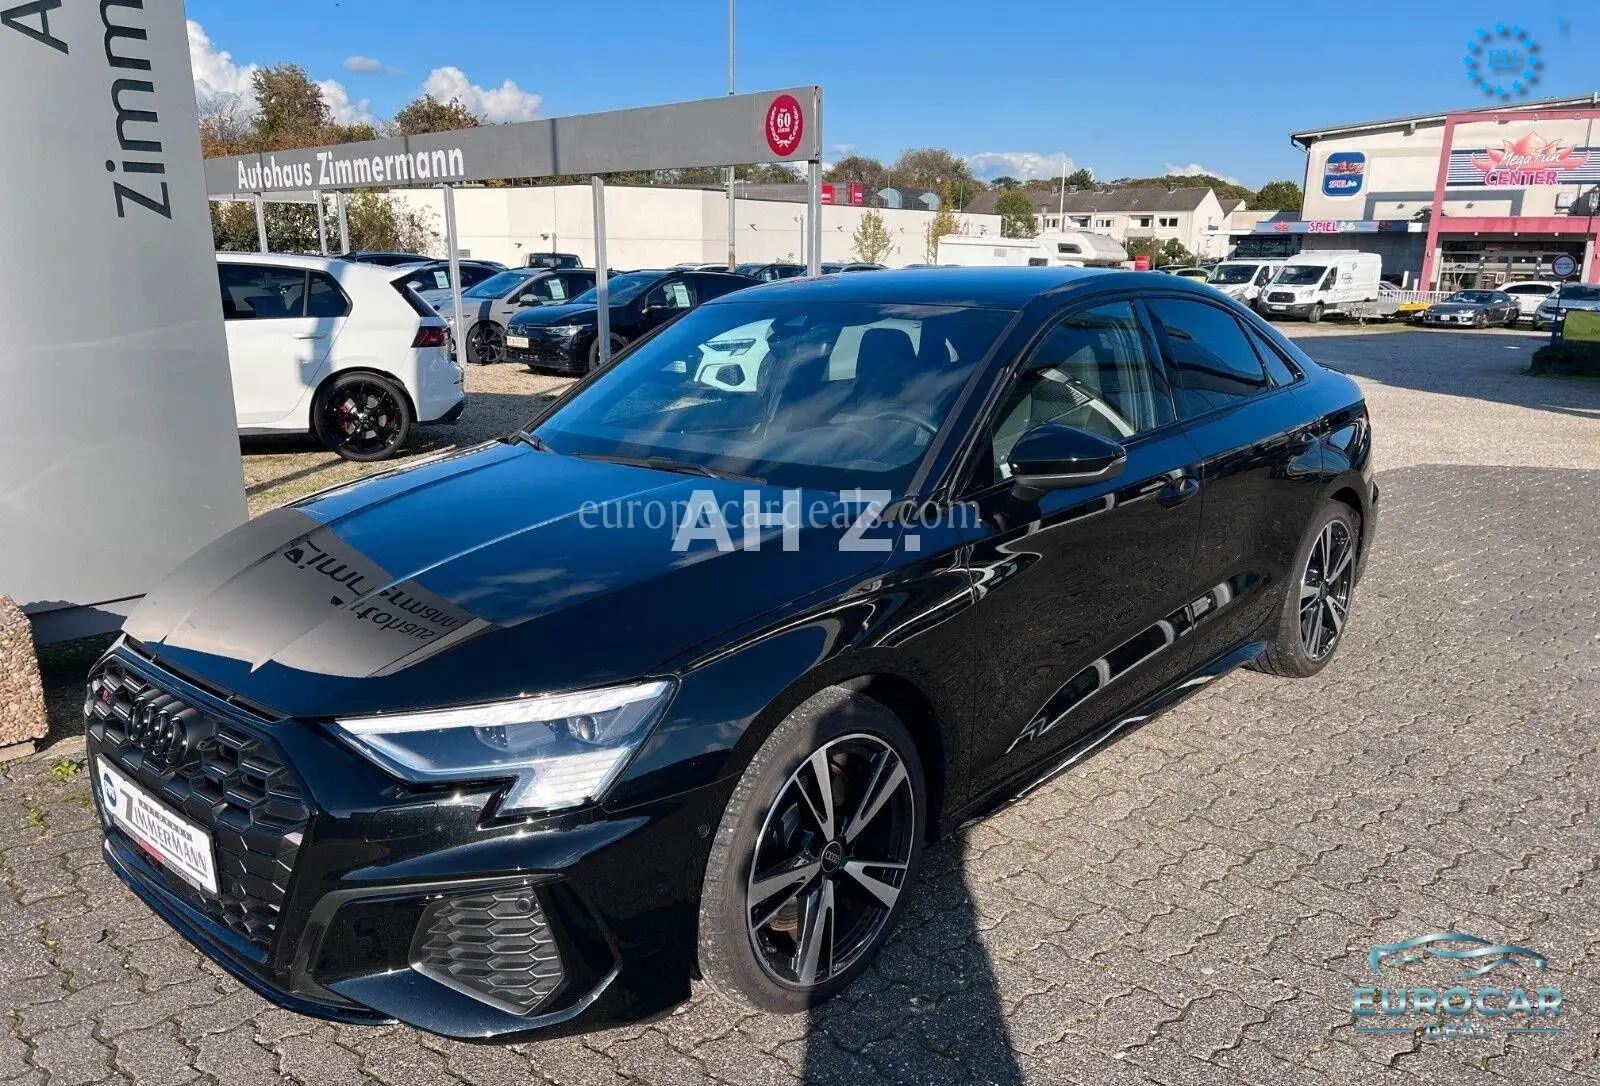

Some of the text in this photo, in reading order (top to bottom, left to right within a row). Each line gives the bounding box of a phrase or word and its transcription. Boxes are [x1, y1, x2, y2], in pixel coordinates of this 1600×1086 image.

[777, 112, 791, 128] 60
[238, 147, 465, 189] Autohaus Zimmermann
[1499, 151, 1532, 172] Mega
[1484, 168, 1560, 186] CENTER
[1309, 220, 1339, 232] SPIEL
